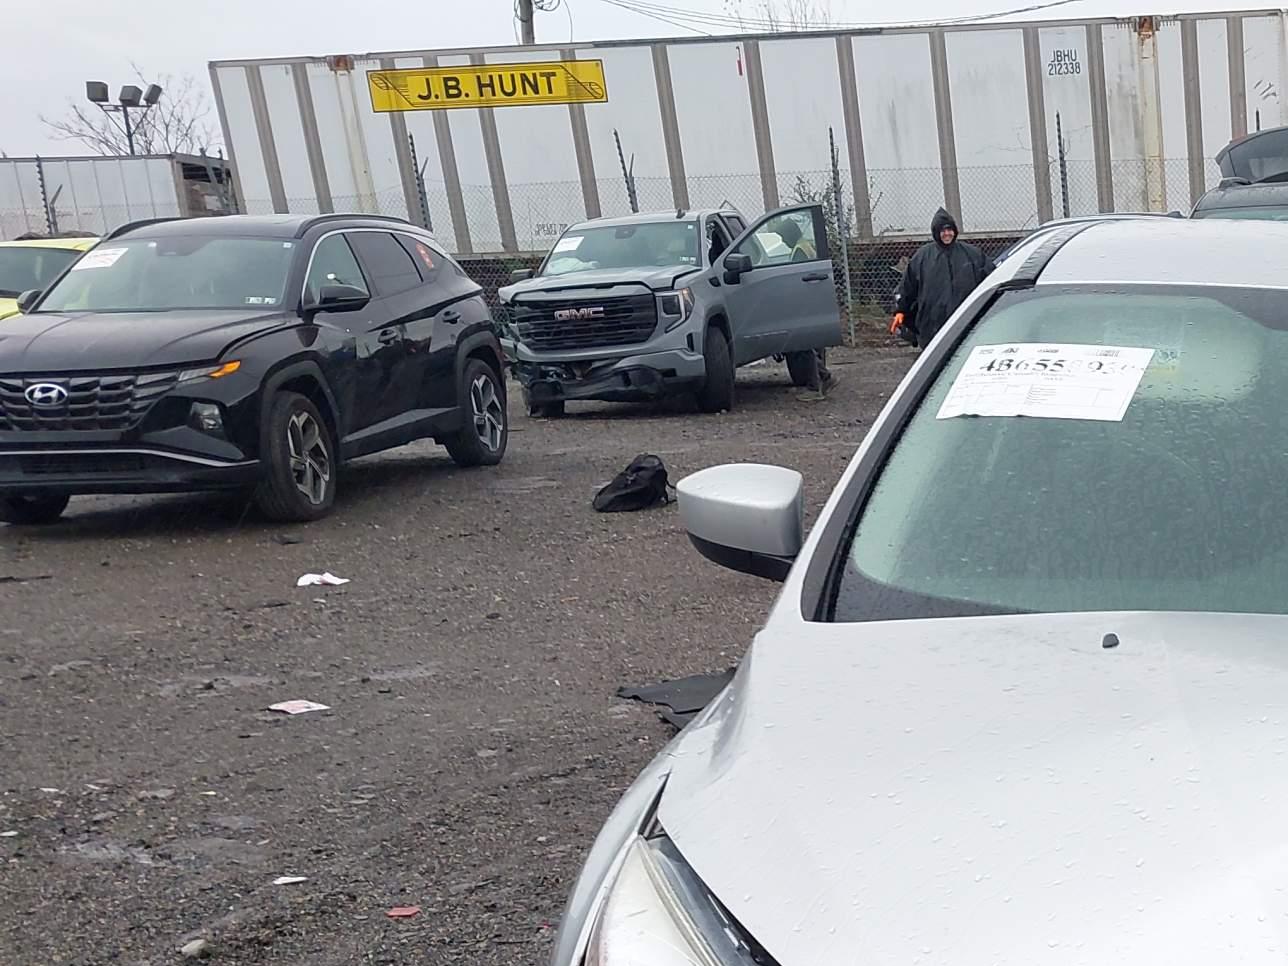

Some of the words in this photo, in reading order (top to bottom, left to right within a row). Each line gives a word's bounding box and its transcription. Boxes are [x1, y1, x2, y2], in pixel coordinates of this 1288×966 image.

[1050, 49, 1077, 62] JBHU
[1048, 62, 1081, 76] 212338
[417, 76, 470, 100] J.B.
[476, 71, 557, 97] HUNT
[553, 306, 605, 321] GMC
